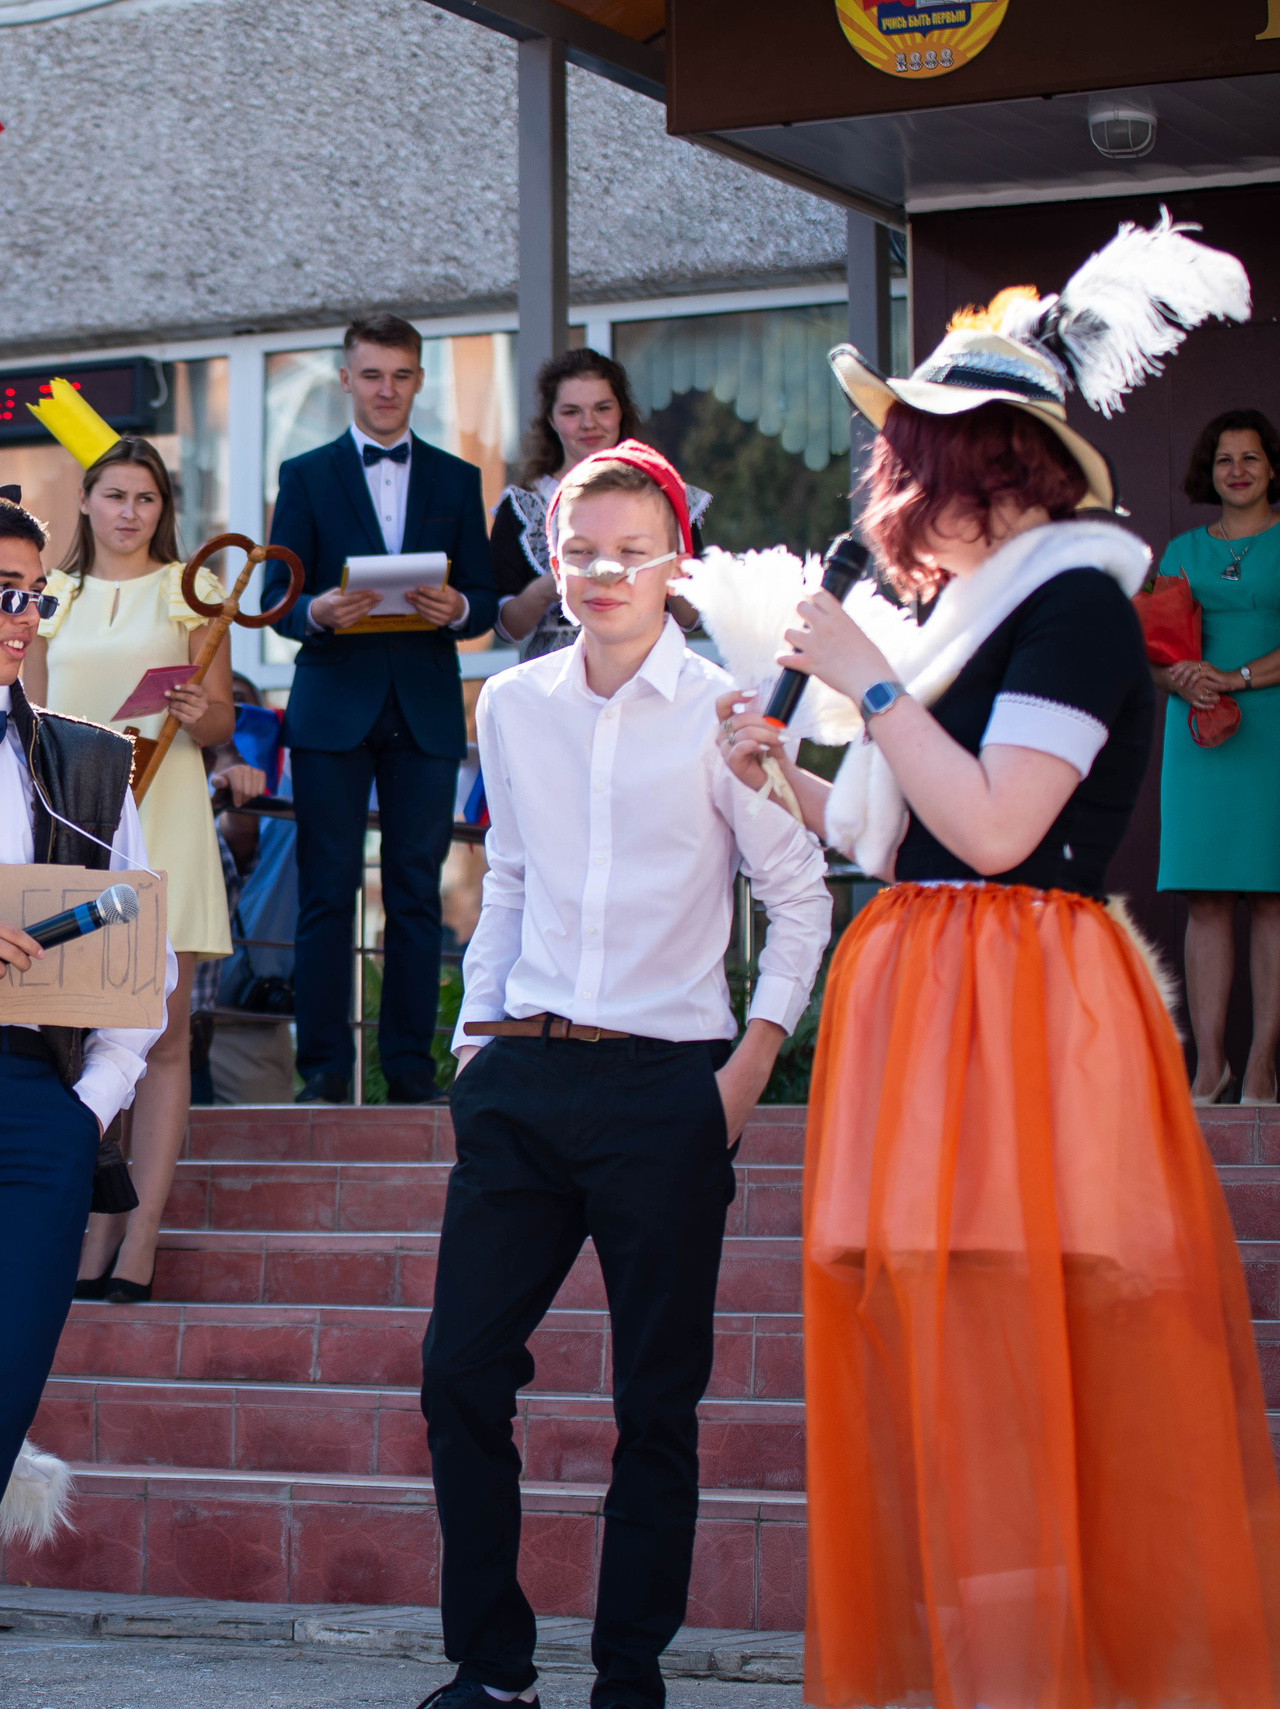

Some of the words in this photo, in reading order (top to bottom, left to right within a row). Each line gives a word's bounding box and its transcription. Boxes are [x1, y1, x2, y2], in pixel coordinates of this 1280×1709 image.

[882, 17, 907, 30] УЧИСЬ
[908, 14, 931, 28] БЫТЬ
[932, 10, 966, 25] ПЕРВЫМ
[895, 48, 954, 72] 1888
